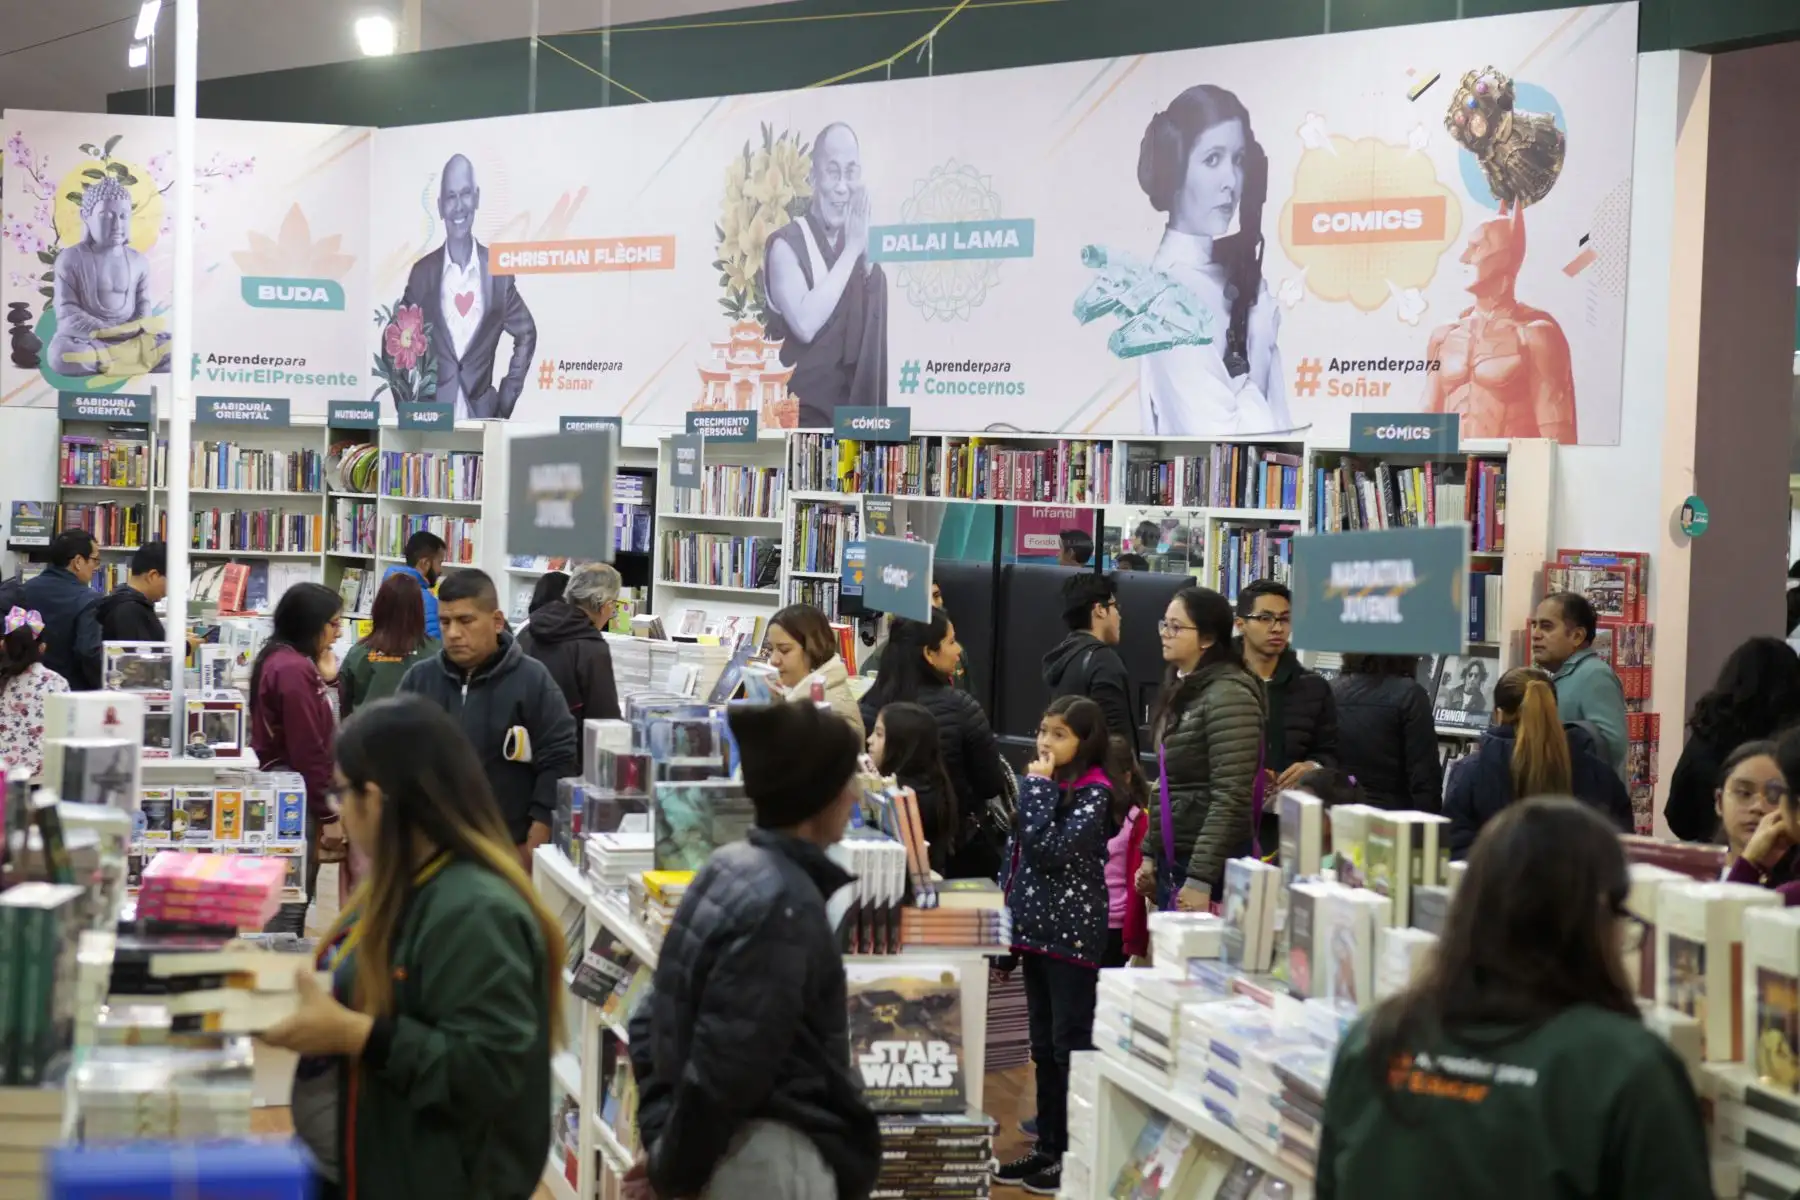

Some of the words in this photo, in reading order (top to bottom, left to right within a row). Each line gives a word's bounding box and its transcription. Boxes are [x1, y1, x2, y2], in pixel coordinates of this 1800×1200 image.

[1312, 209, 1423, 232] COMICS
[882, 231, 947, 252] DALAI
[953, 228, 1020, 250] LAMA
[499, 250, 589, 268] CHRISTIAN
[594, 242, 663, 265] FLÈCHE
[259, 285, 330, 303] BUDA
[207, 368, 358, 387] VivirElPresente
[557, 376, 593, 391] Sanar
[924, 378, 1026, 396] Conocernos
[1327, 377, 1391, 397] Soñar
[75, 396, 136, 408] SABIDURÍA
[212, 401, 273, 412] SABIDURÍA
[78, 407, 133, 416] ORIENTAL
[215, 410, 270, 421] ORIENTAL
[334, 409, 375, 420] NUTRICIÓN
[412, 411, 439, 422] SALUD
[693, 417, 750, 427] CRECIMIENTO
[851, 416, 891, 430] CÓMICS
[700, 427, 744, 437] PERSONAL
[1375, 423, 1432, 440] CÓMICS
[1032, 507, 1077, 519] Infantil
[1029, 538, 1056, 546] Fondo
[1435, 708, 1467, 722] LENNON
[859, 1041, 957, 1064] STAR
[859, 1063, 958, 1087] WARS
